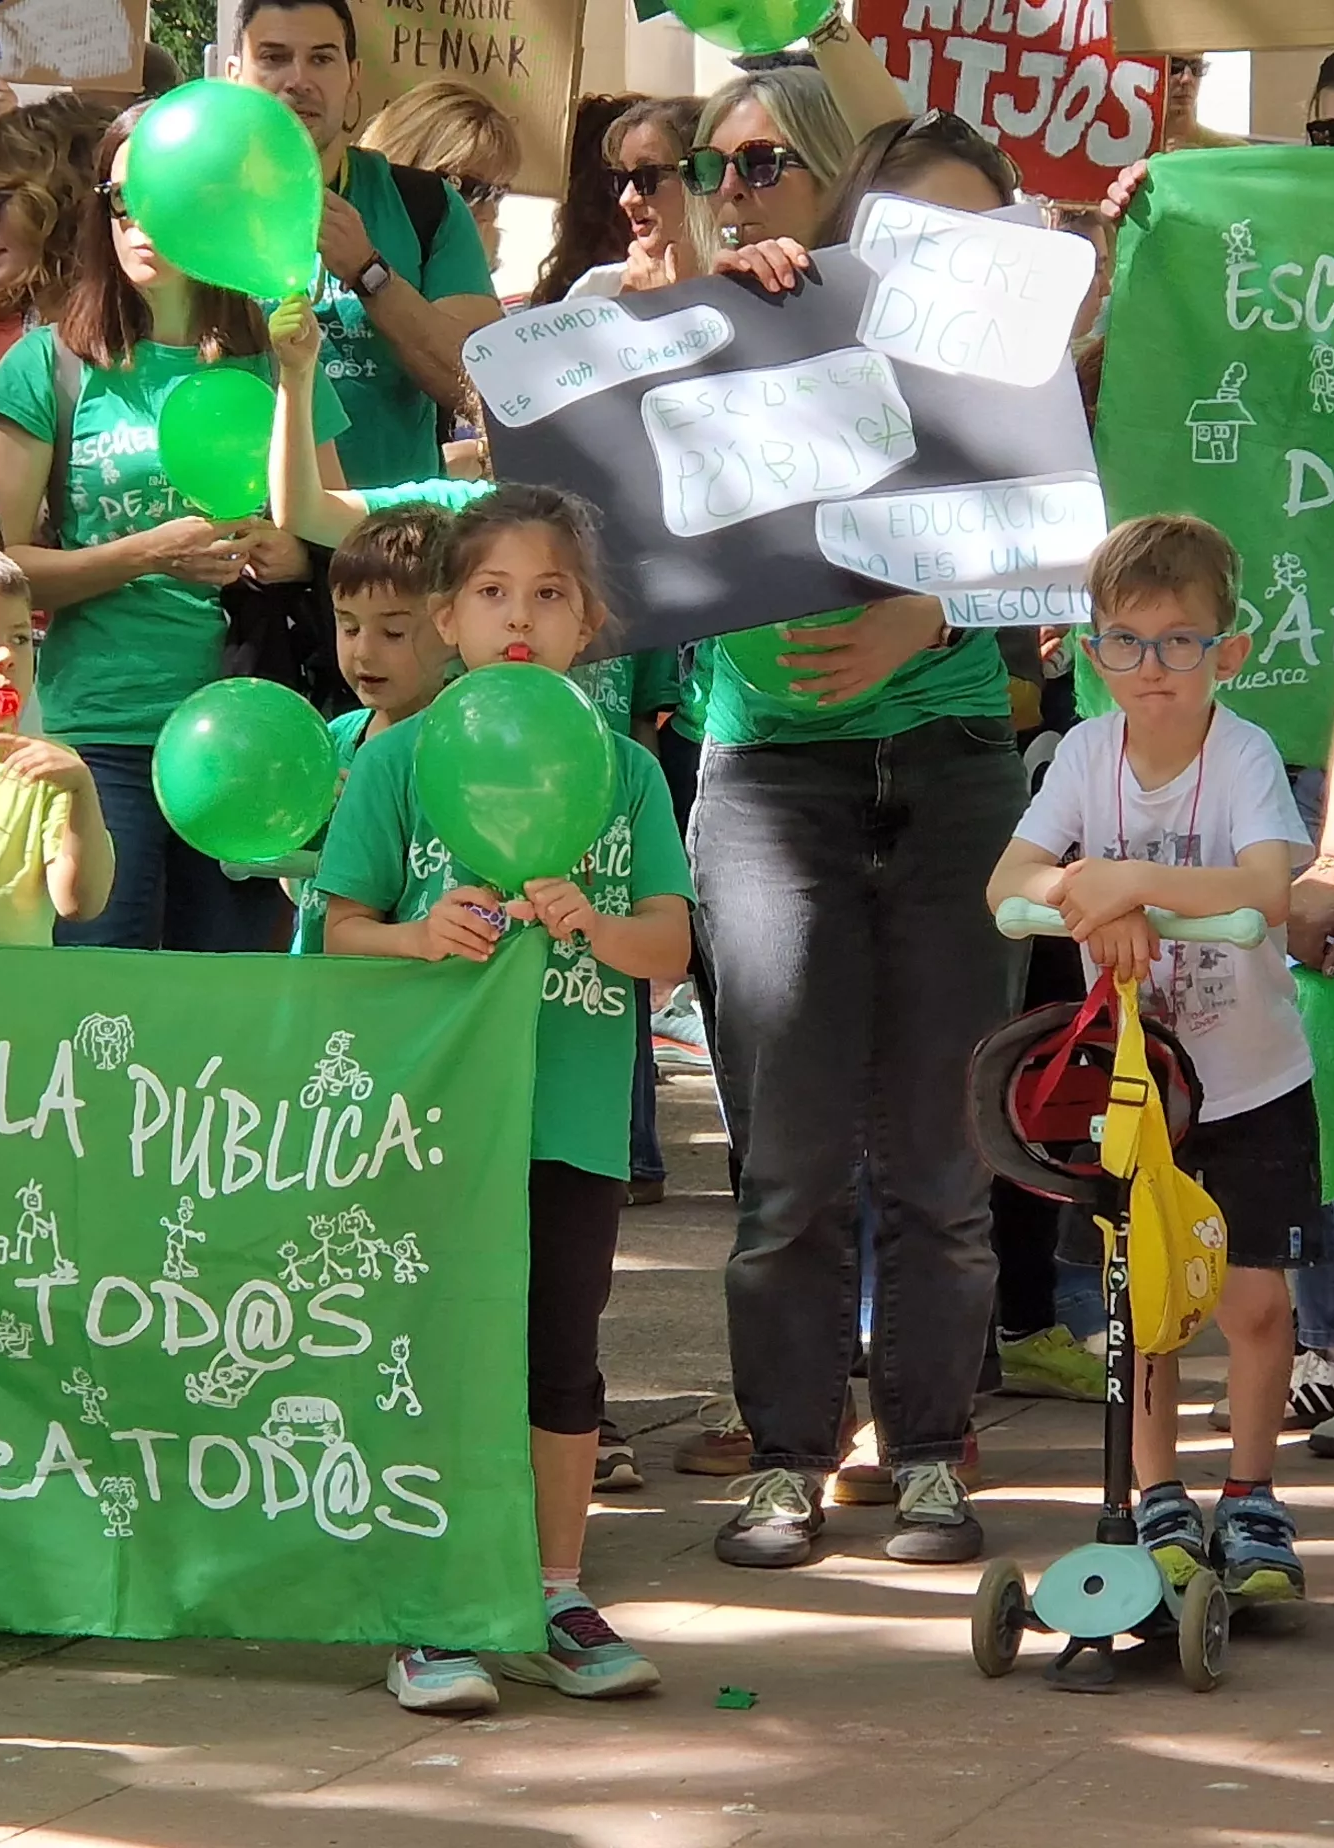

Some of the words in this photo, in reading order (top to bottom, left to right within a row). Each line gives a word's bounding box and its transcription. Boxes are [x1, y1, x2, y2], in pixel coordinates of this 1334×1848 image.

[390, 23, 530, 78] PENSAR
[465, 343, 493, 363] LA
[500, 394, 531, 417] ES
[98, 488, 144, 522] DE
[821, 504, 861, 543] LA
[914, 551, 956, 582] ES
[990, 544, 1038, 577] UN
[540, 967, 627, 1017] OD@S
[128, 1056, 443, 1199] PÚBLICA:
[16, 1275, 374, 1371] TOD@S
[110, 1427, 448, 1539] TOD@S
